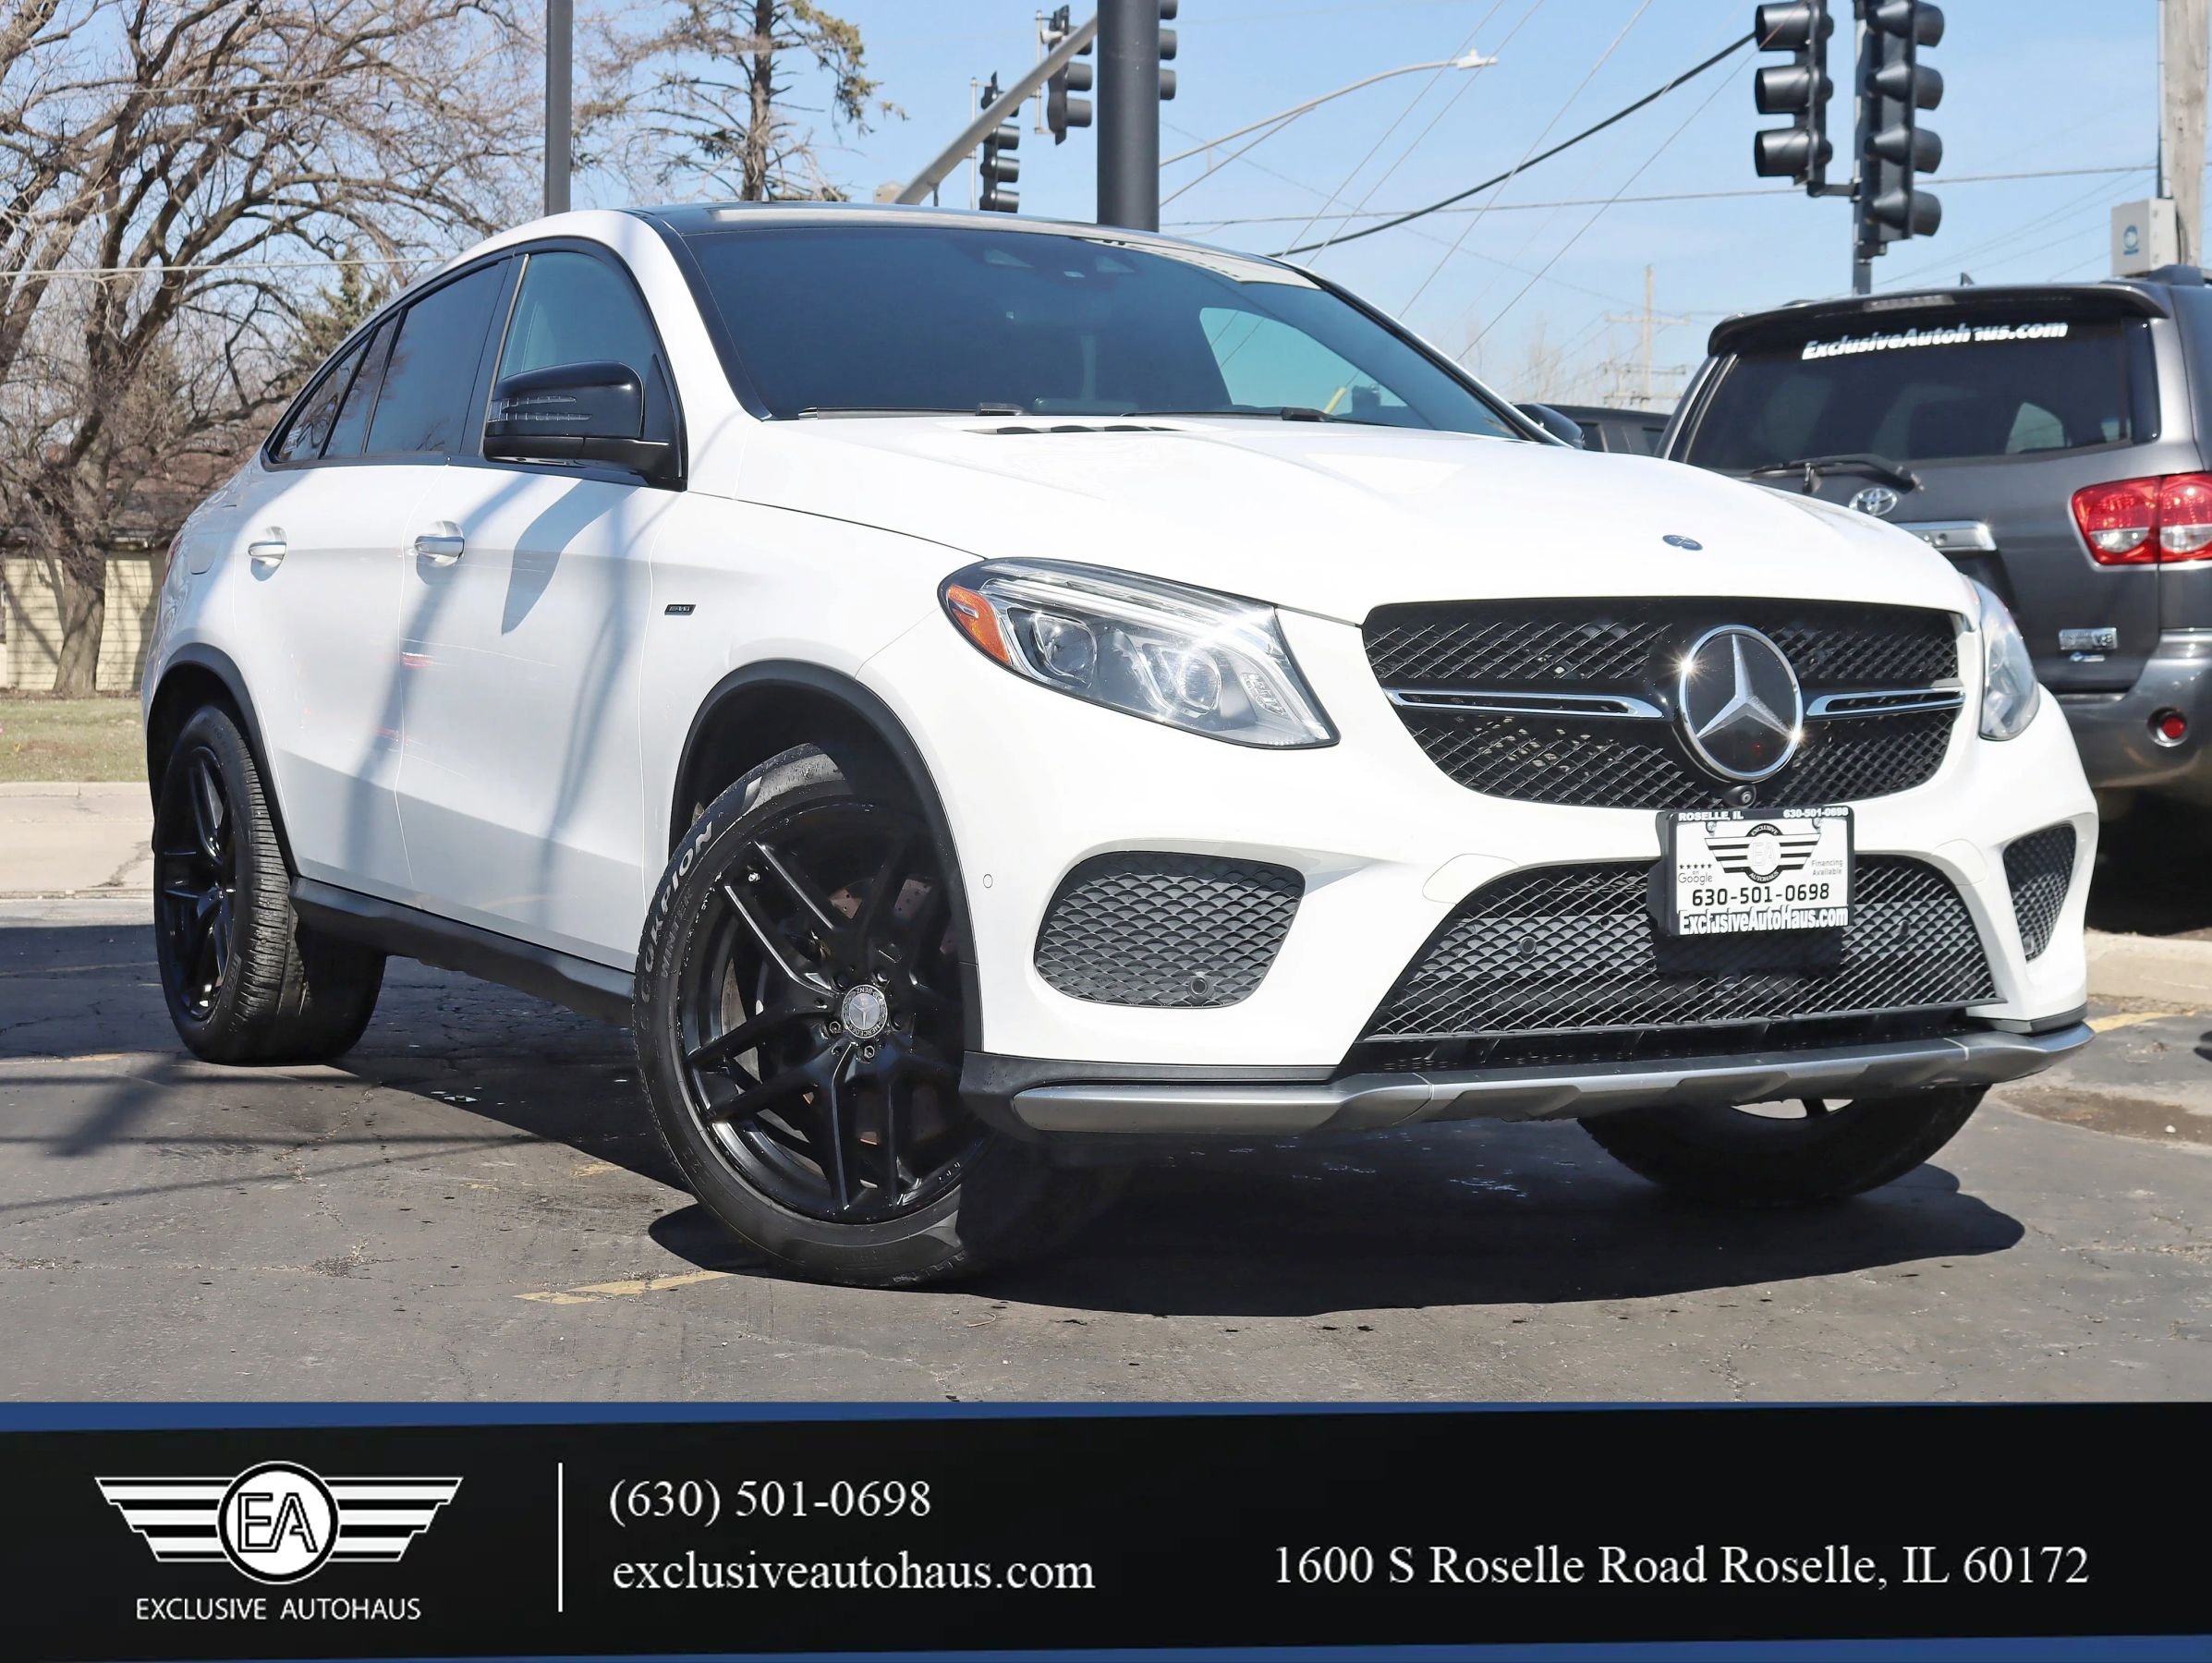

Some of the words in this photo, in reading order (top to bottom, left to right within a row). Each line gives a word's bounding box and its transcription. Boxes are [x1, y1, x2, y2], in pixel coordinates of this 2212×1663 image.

[1679, 811, 1731, 821] ROSELLE,
[1733, 811, 1744, 820] IL
[1783, 808, 1849, 819] 630-501-0698
[1811, 859, 1843, 868] Financing
[1812, 868, 1842, 876] Available
[1678, 872, 1713, 886] Google
[1692, 883, 1830, 906] 630-501-0698
[1679, 904, 1849, 935] ExclusiveAutoHaus.com
